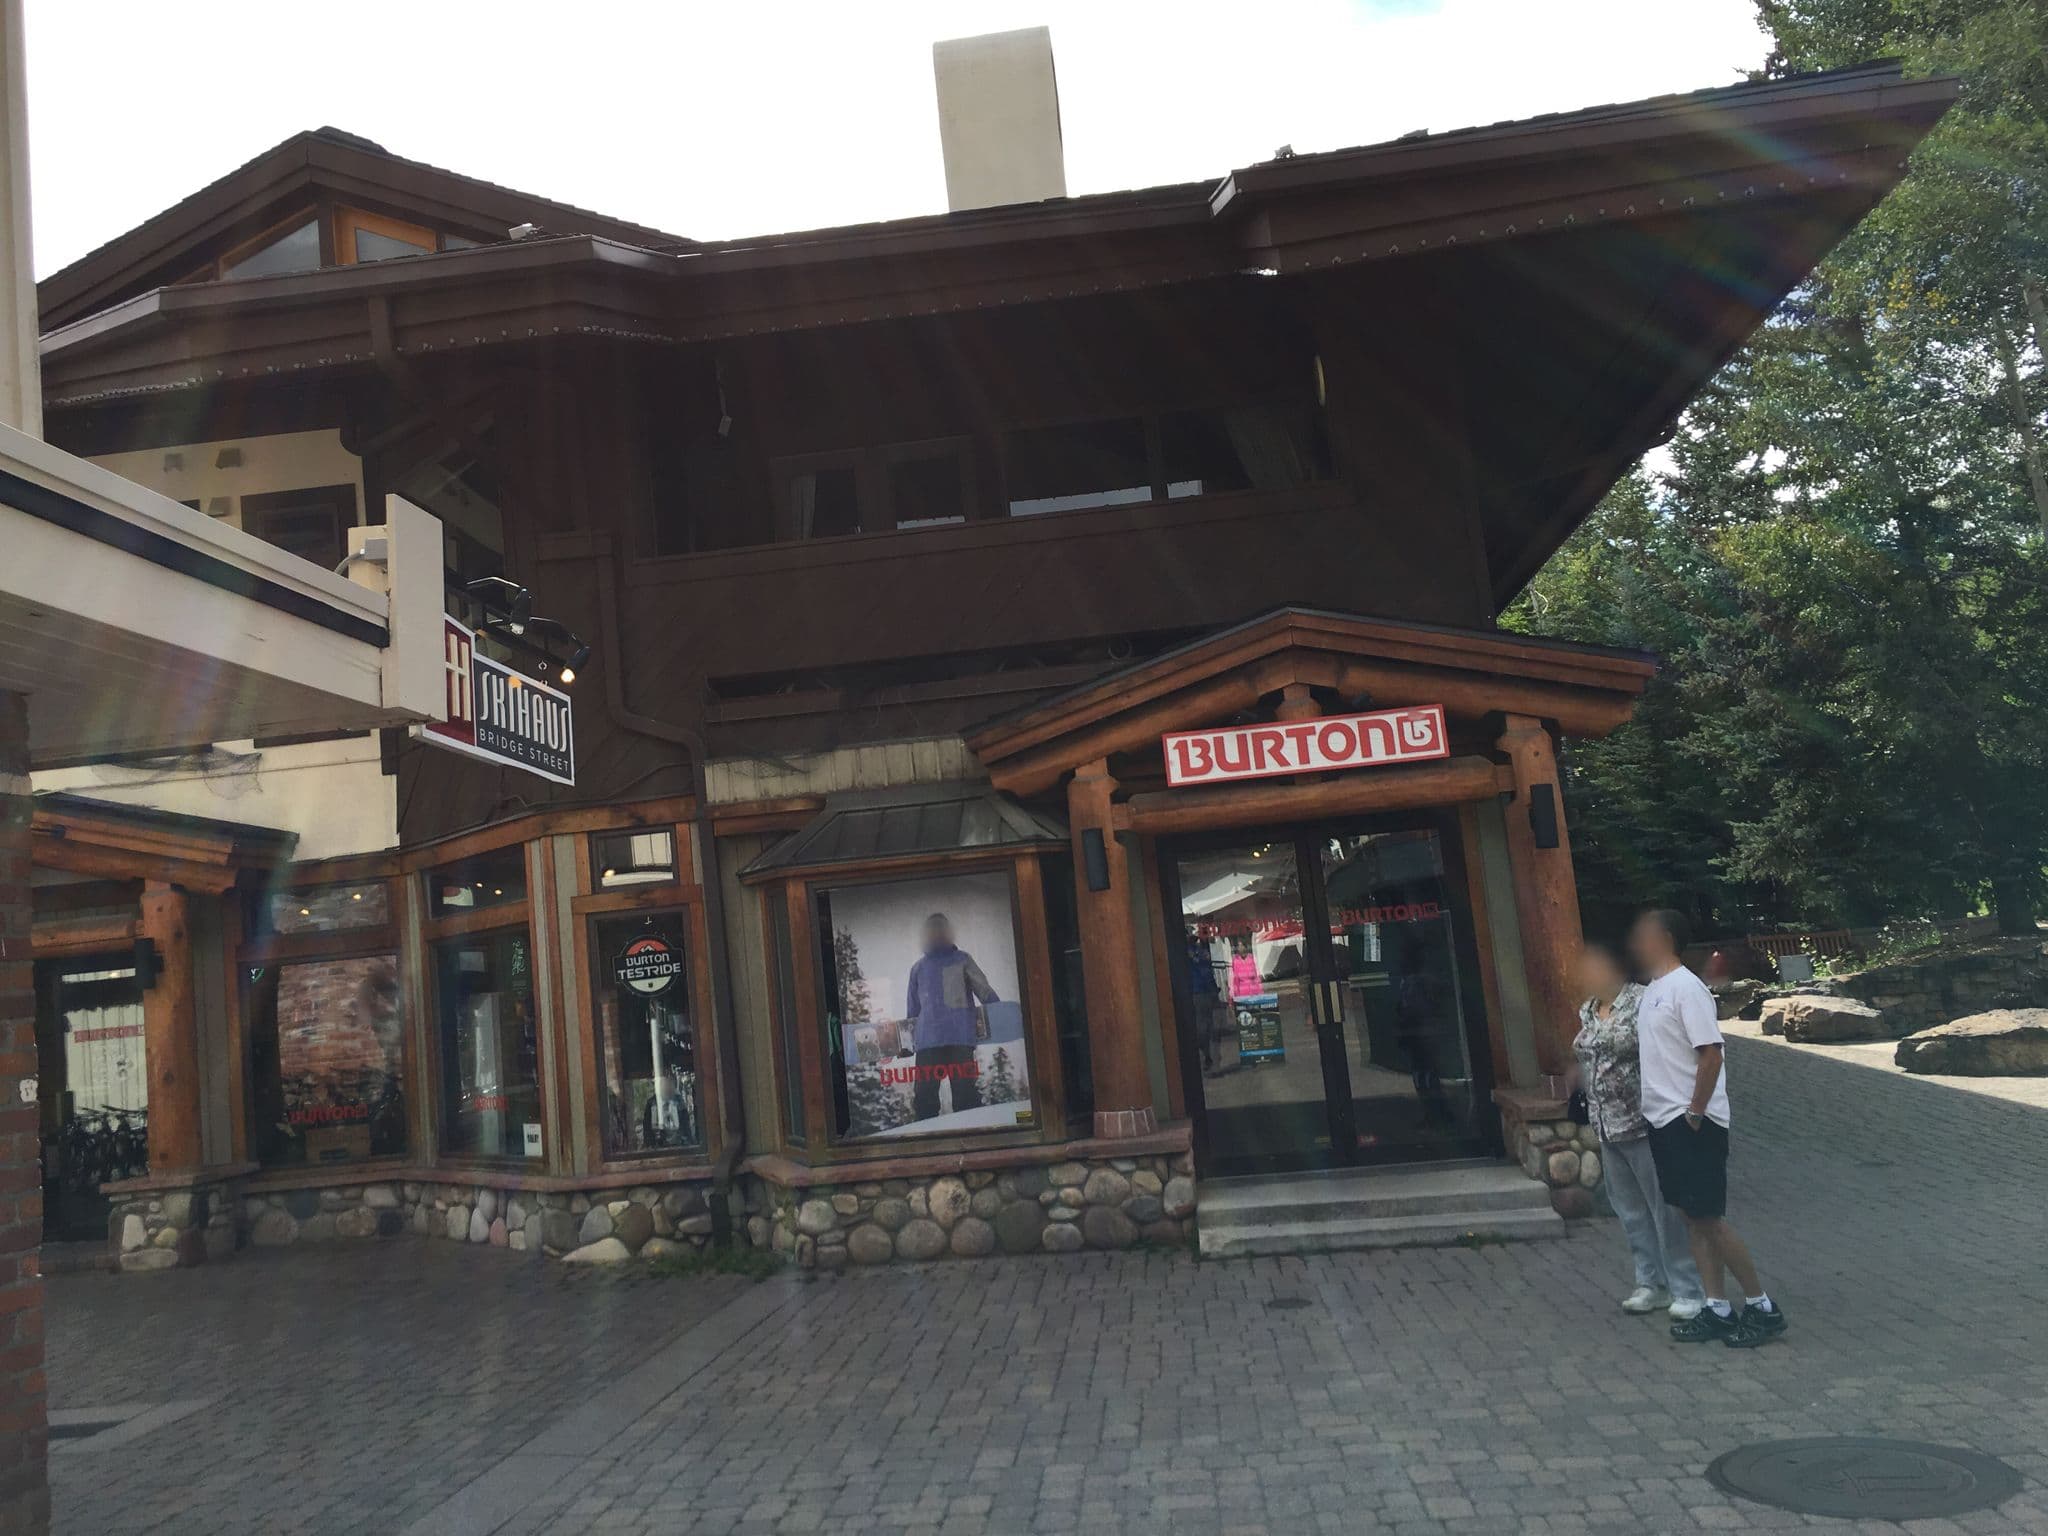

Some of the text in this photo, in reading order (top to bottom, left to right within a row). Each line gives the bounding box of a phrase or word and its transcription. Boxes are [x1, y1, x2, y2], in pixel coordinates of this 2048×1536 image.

[480, 728, 568, 772] BRIDGE STREET
[1172, 718, 1397, 779] BURTON
[1340, 903, 1423, 926] BURTON
[617, 962, 681, 980] TESTRIDE
[626, 952, 670, 967] BURTON
[880, 1062, 968, 1087] BURTON
